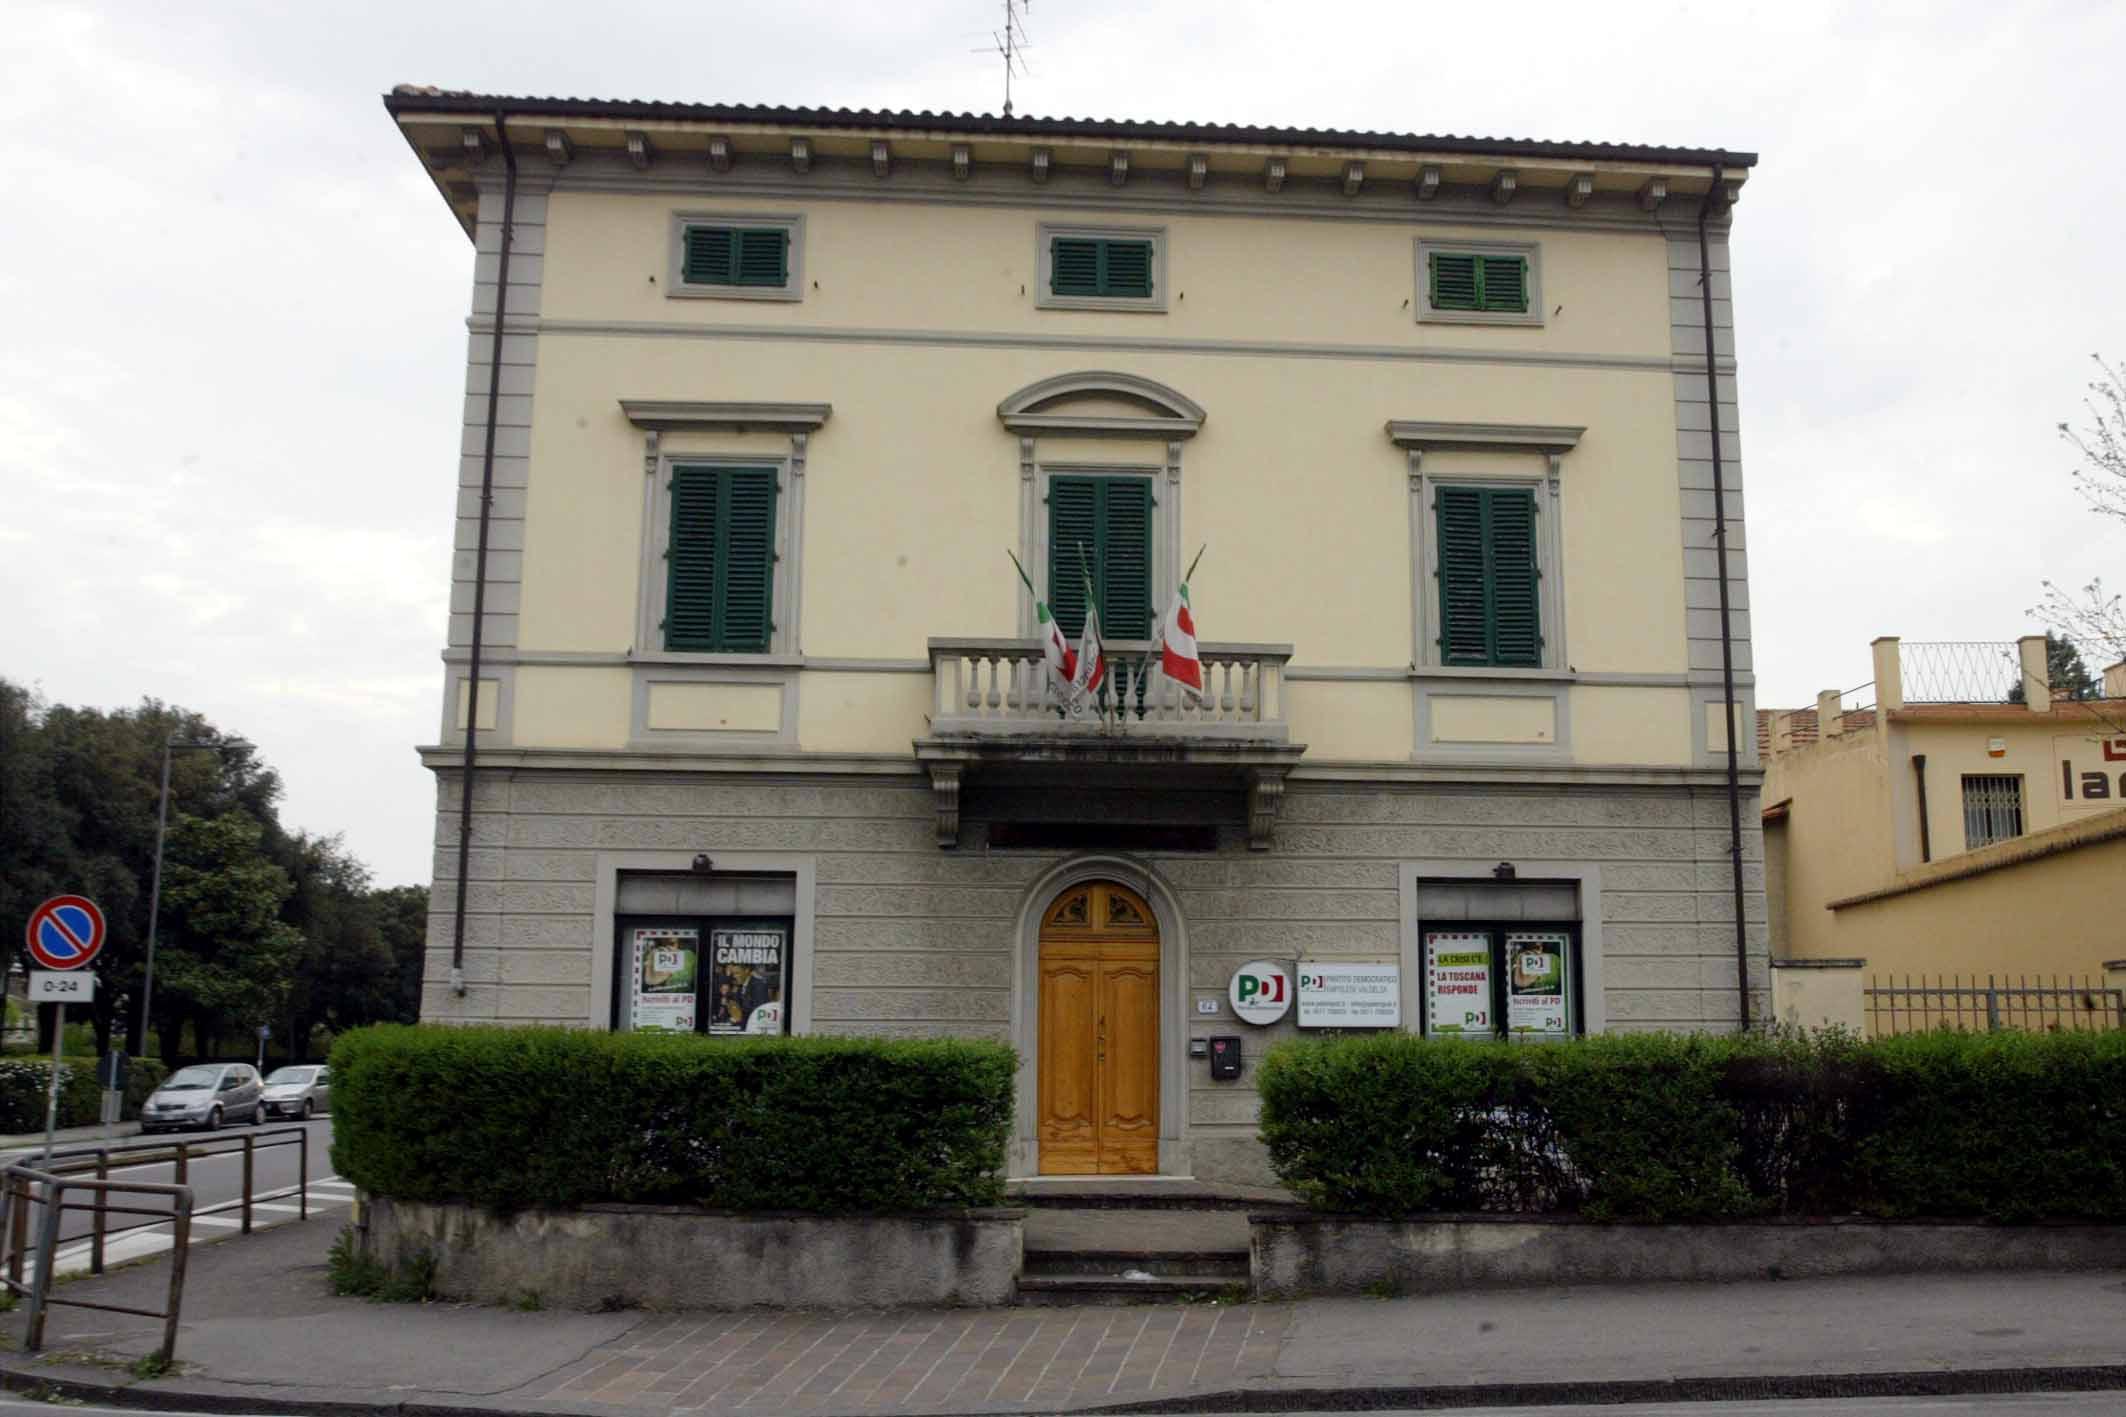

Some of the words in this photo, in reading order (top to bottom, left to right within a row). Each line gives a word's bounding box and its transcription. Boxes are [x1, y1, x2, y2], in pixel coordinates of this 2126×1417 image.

[717, 934, 730, 948] IL
[732, 934, 780, 948] MONDO
[716, 948, 779, 964] CAMBIA
[1437, 971, 1447, 981] LA
[1448, 971, 1487, 981] TOSCANA
[43, 980, 78, 993] 0-24
[1238, 974, 1284, 1003] PD
[1438, 984, 1478, 994] RISPONDE
